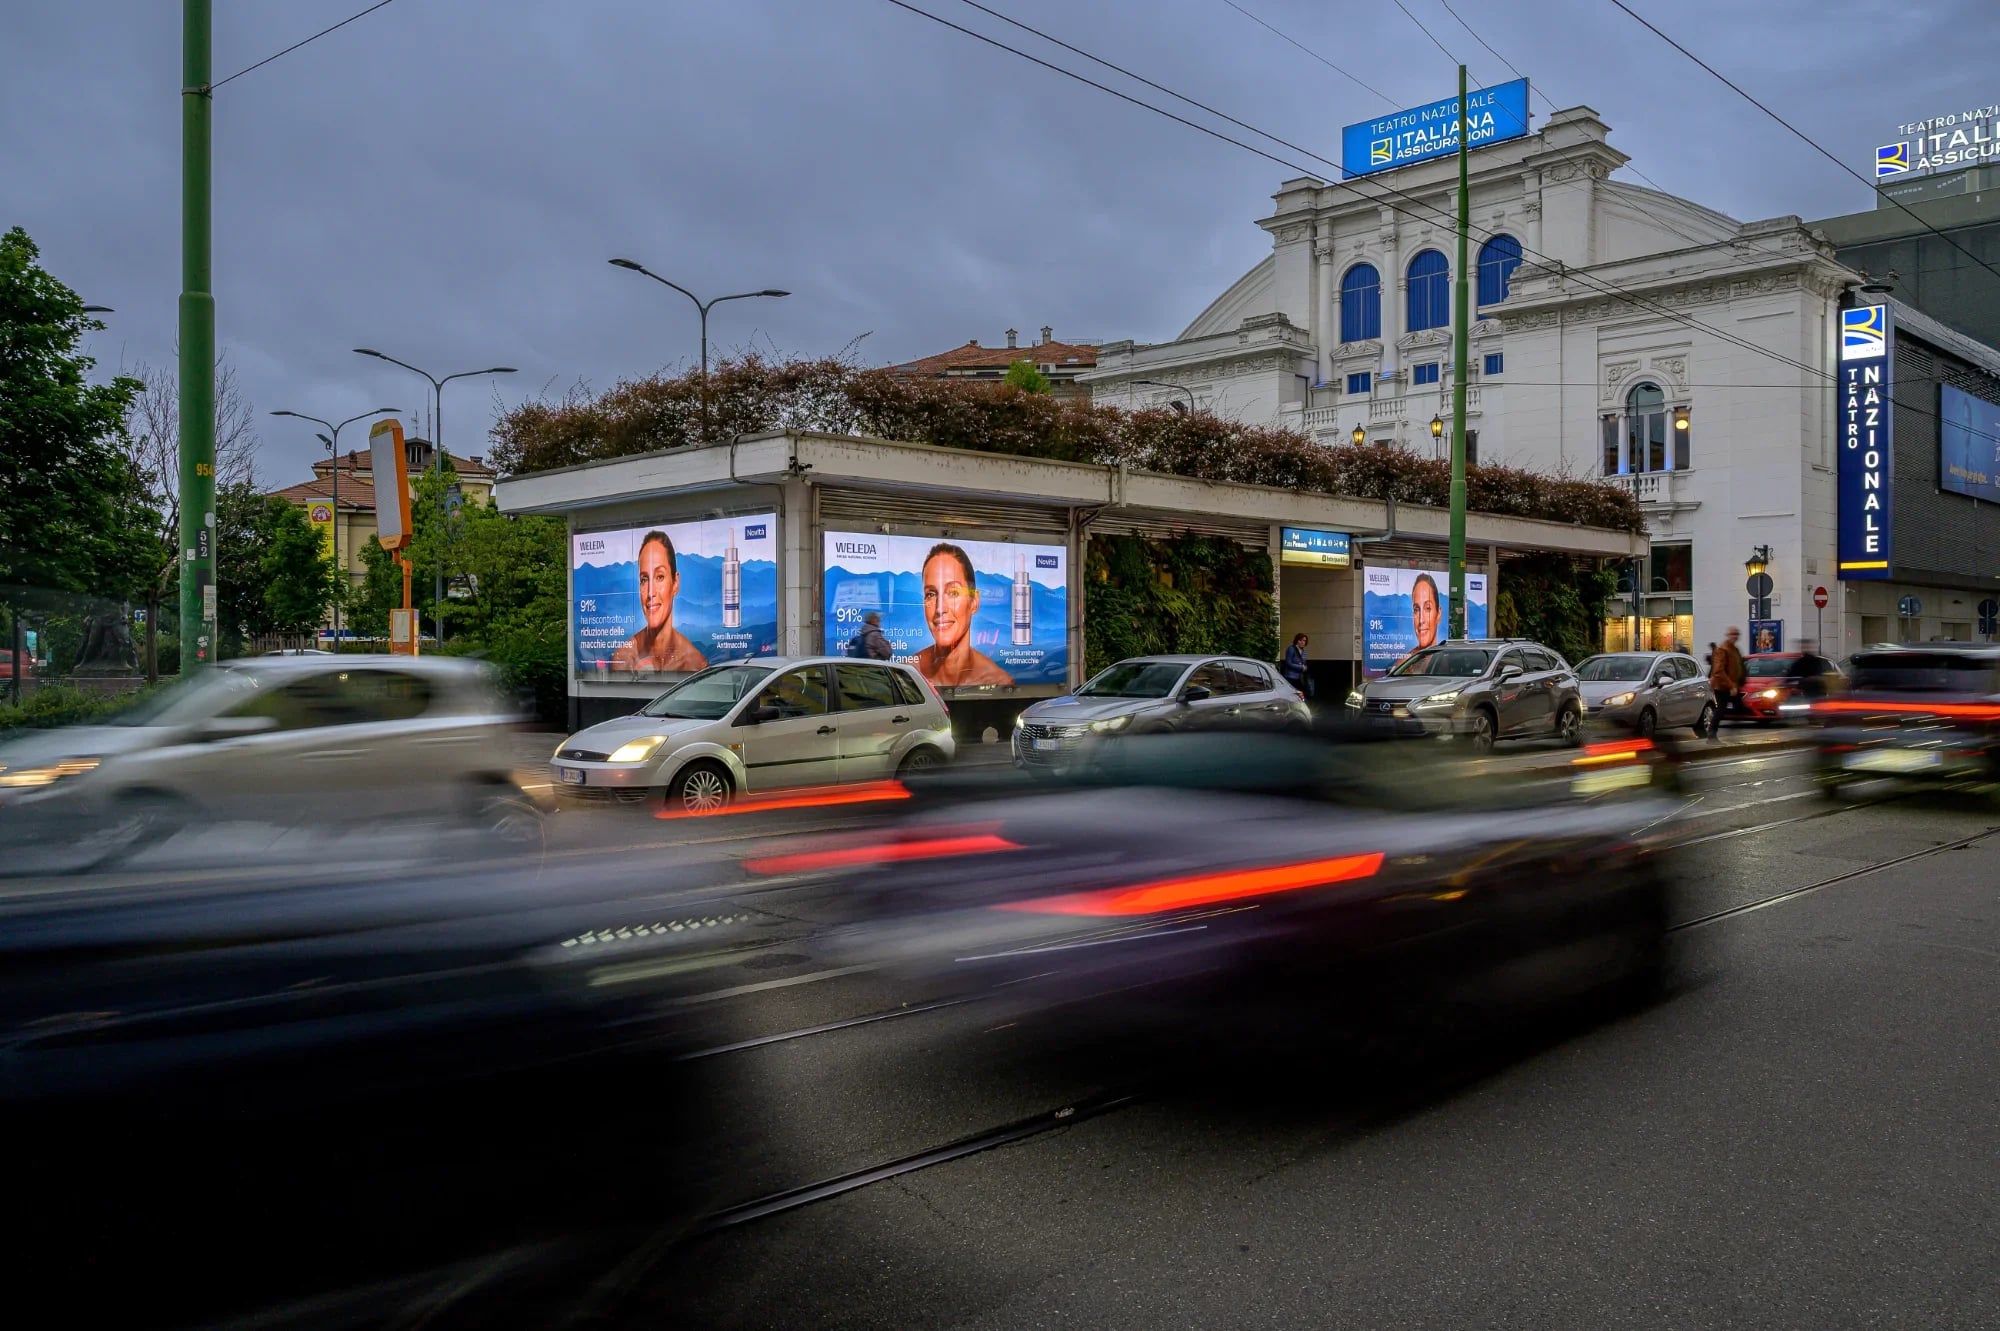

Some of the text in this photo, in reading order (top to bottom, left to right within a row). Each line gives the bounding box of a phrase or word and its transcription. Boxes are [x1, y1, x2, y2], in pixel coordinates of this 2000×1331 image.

[1371, 113, 1417, 136] TEATRO
[1396, 111, 1495, 149] ITALIANA
[1898, 114, 1956, 136] TEATRO
[1396, 126, 1495, 160] ASSICURAIONI
[1847, 368, 1858, 449] TEATRO
[1864, 366, 1880, 553] NAZIONALE
[580, 540, 605, 551] WELEDA
[836, 542, 877, 555] WELEDA
[1037, 558, 1057, 566] Novità
[580, 599, 597, 612] 91%
[589, 614, 622, 625] riscontrato
[836, 608, 863, 622] 91%
[1370, 619, 1384, 630] 91%
[580, 626, 625, 637] riduzione delle
[836, 625, 849, 637] ha
[905, 628, 923, 637] una
[580, 640, 606, 649] macchie
[889, 639, 908, 650] elle
[1004, 657, 1039, 665] Antimacchie
